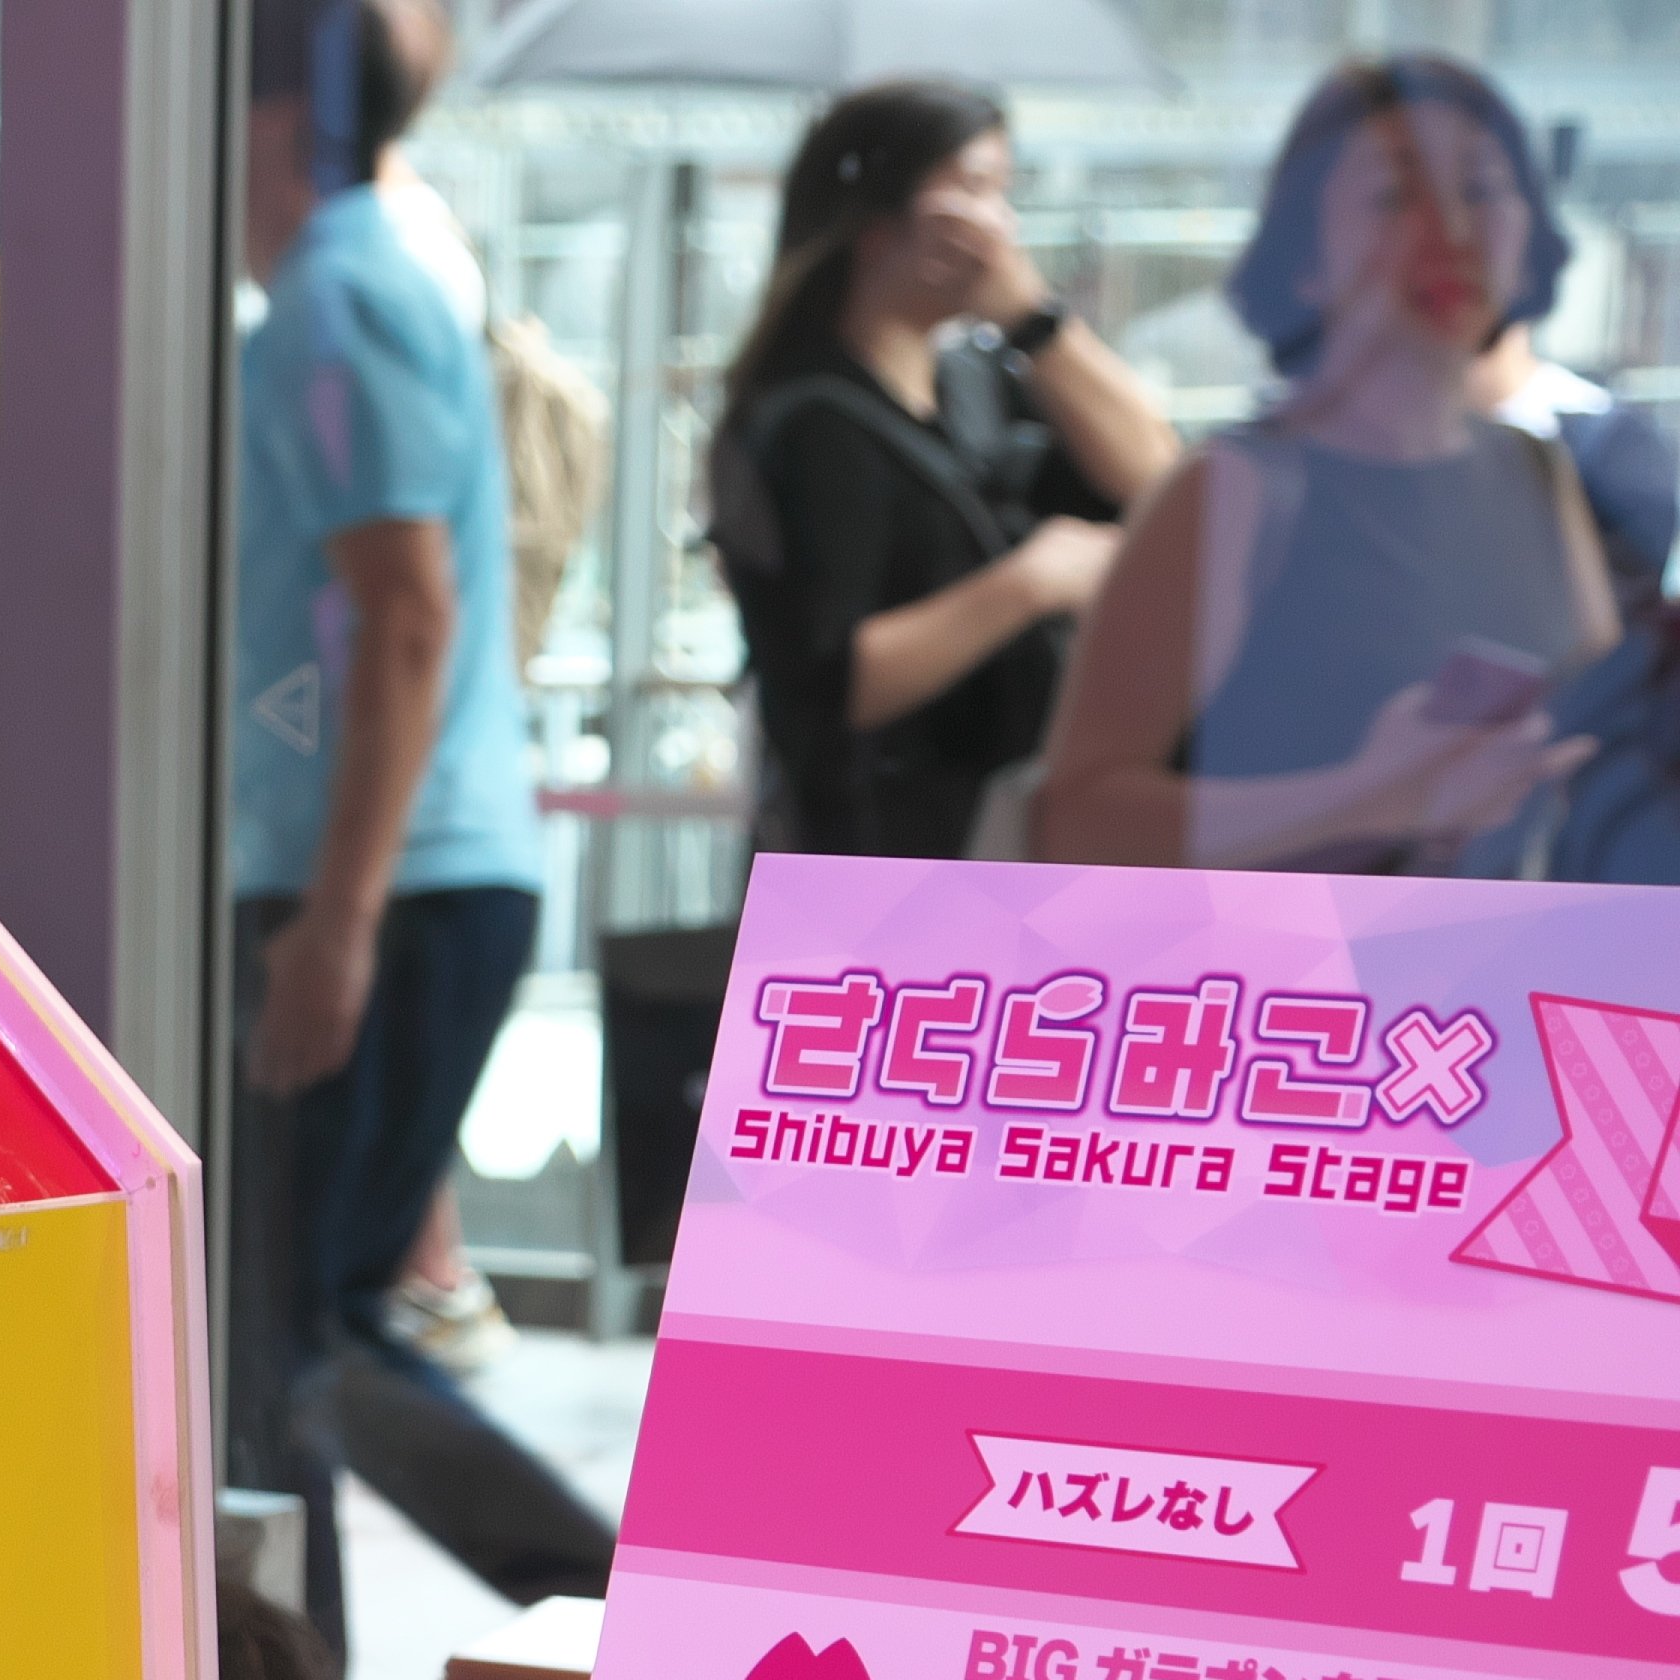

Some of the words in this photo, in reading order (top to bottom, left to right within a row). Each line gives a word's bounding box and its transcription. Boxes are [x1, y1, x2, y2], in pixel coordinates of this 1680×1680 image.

[730, 1109, 973, 1179] Shibuya
[999, 1126, 1235, 1192] Sakura
[1263, 1143, 1468, 1213] Stage
[1006, 1470, 1255, 1537] ハズレなし
[1400, 1498, 1569, 1600] 1回
